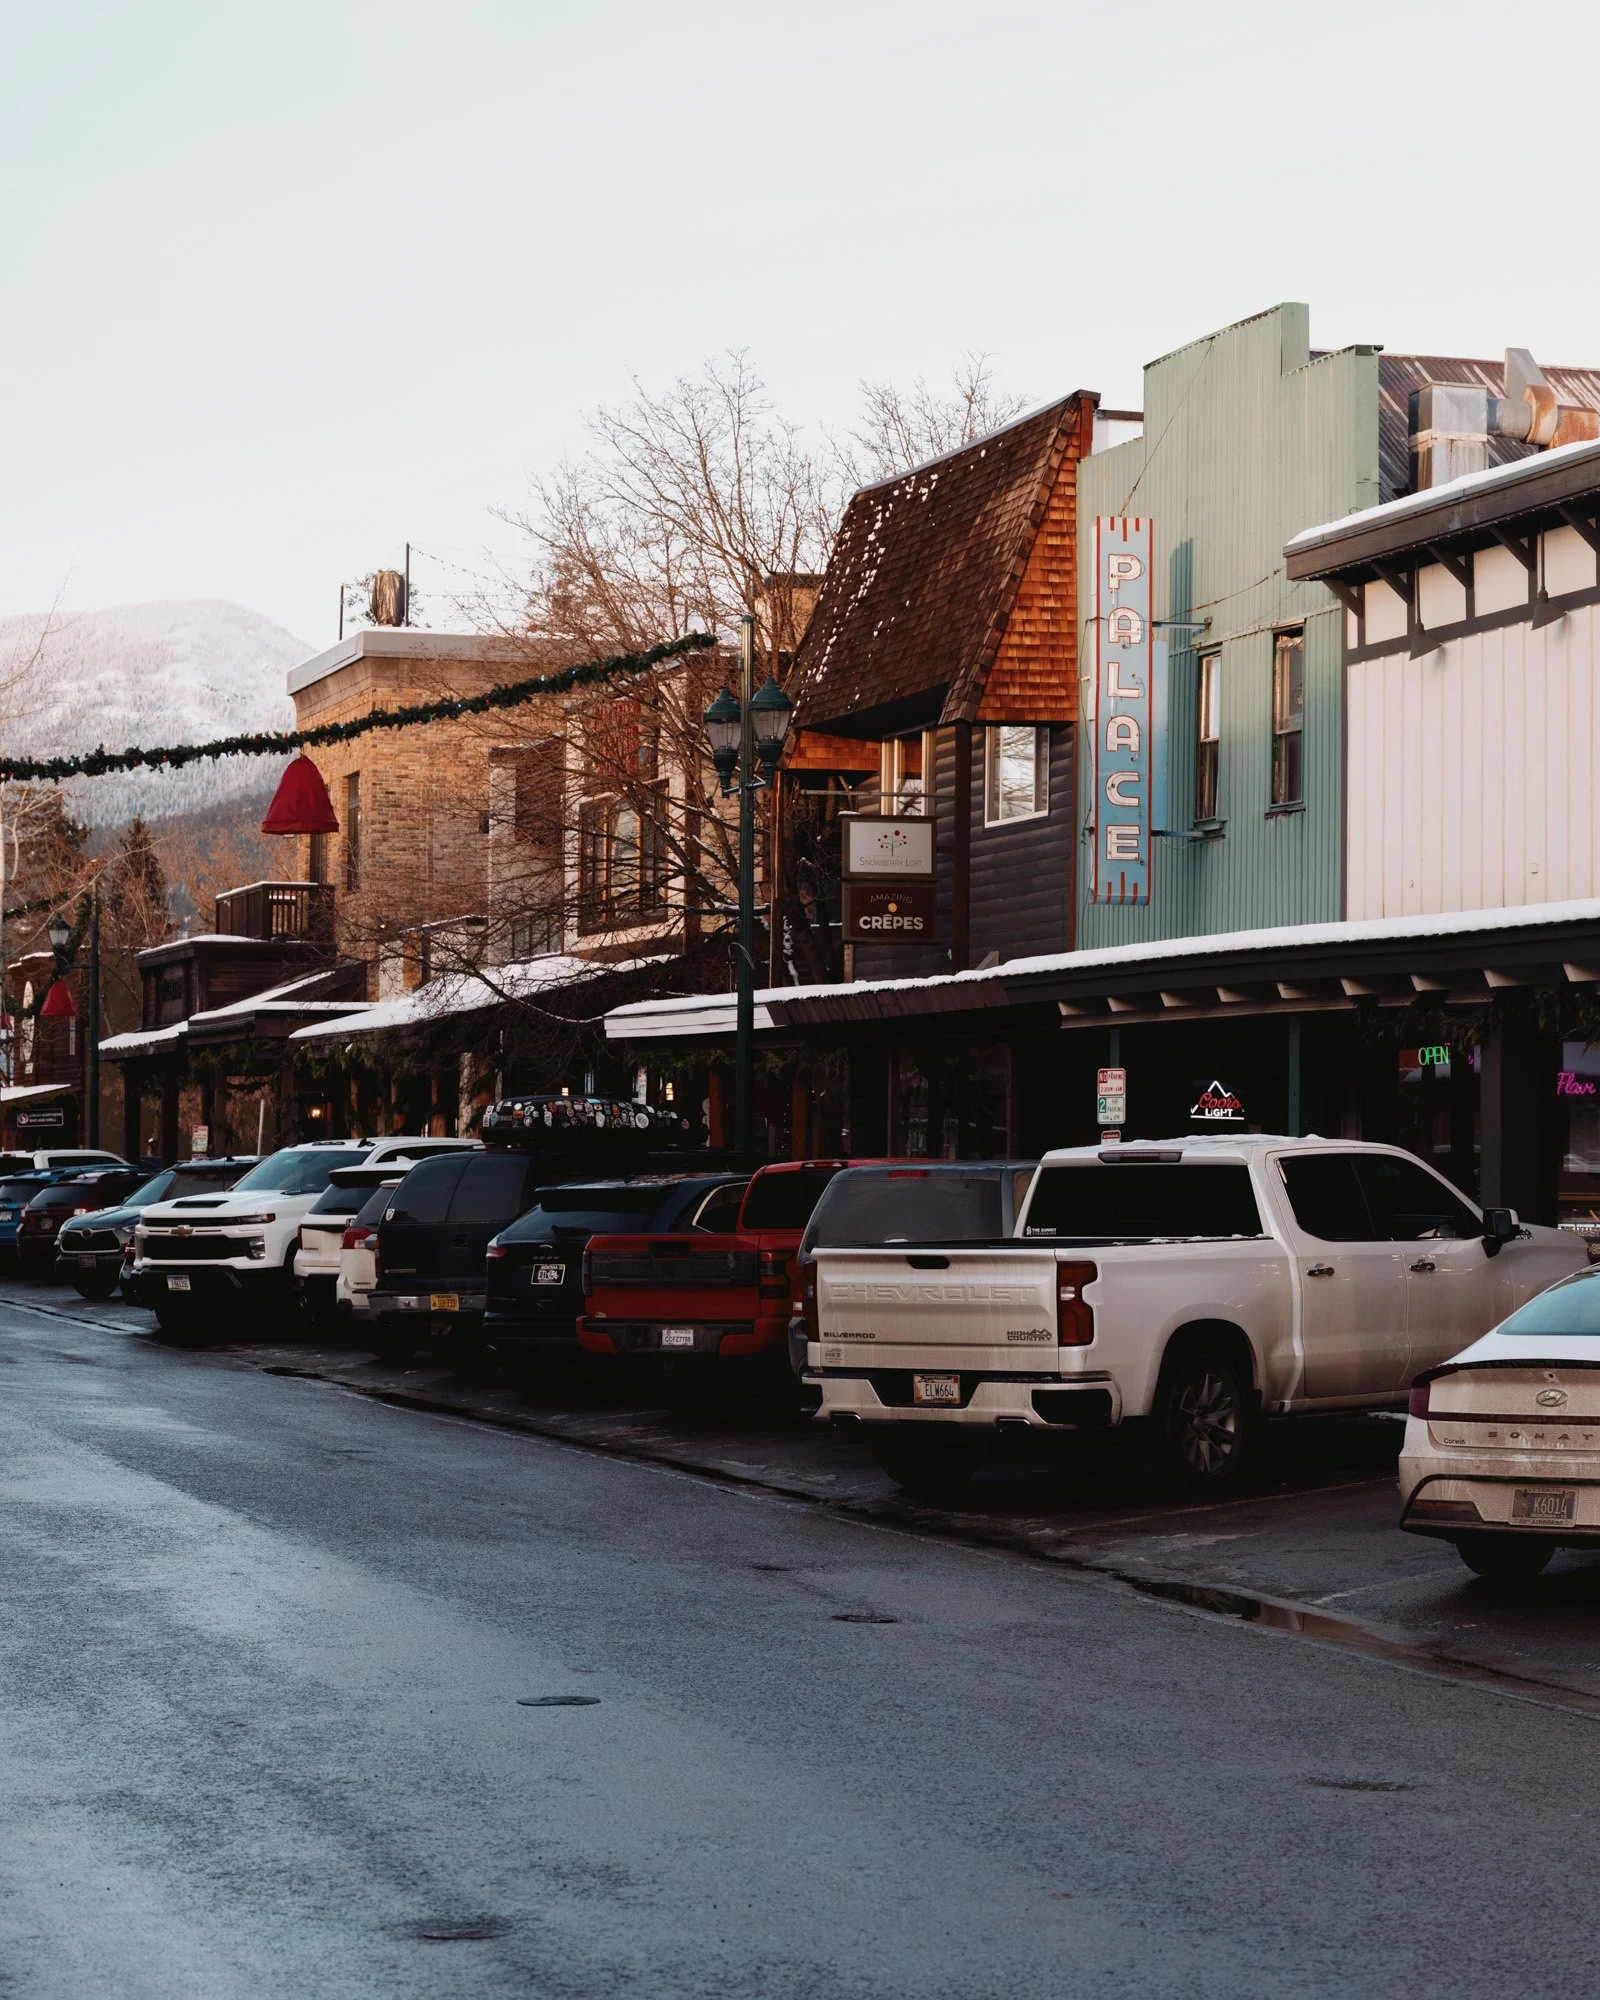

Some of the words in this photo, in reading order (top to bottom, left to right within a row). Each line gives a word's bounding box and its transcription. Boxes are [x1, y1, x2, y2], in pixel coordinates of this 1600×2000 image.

[1105, 553, 1142, 861] PALACE
[870, 893, 913, 904] AMAZING
[859, 914, 924, 930] CRÊPES
[1418, 1046, 1449, 1066] OPEN
[1099, 1070, 1107, 1083] NO
[1099, 1098, 1106, 1113] 2
[1199, 1092, 1242, 1109] Coors
[1205, 1108, 1233, 1117] LIGHT
[830, 1284, 1036, 1302] CHEVROLET
[925, 1383, 954, 1397] ELW664
[1443, 1437, 1466, 1445] Corwin
[1533, 1496, 1568, 1515] K6014
